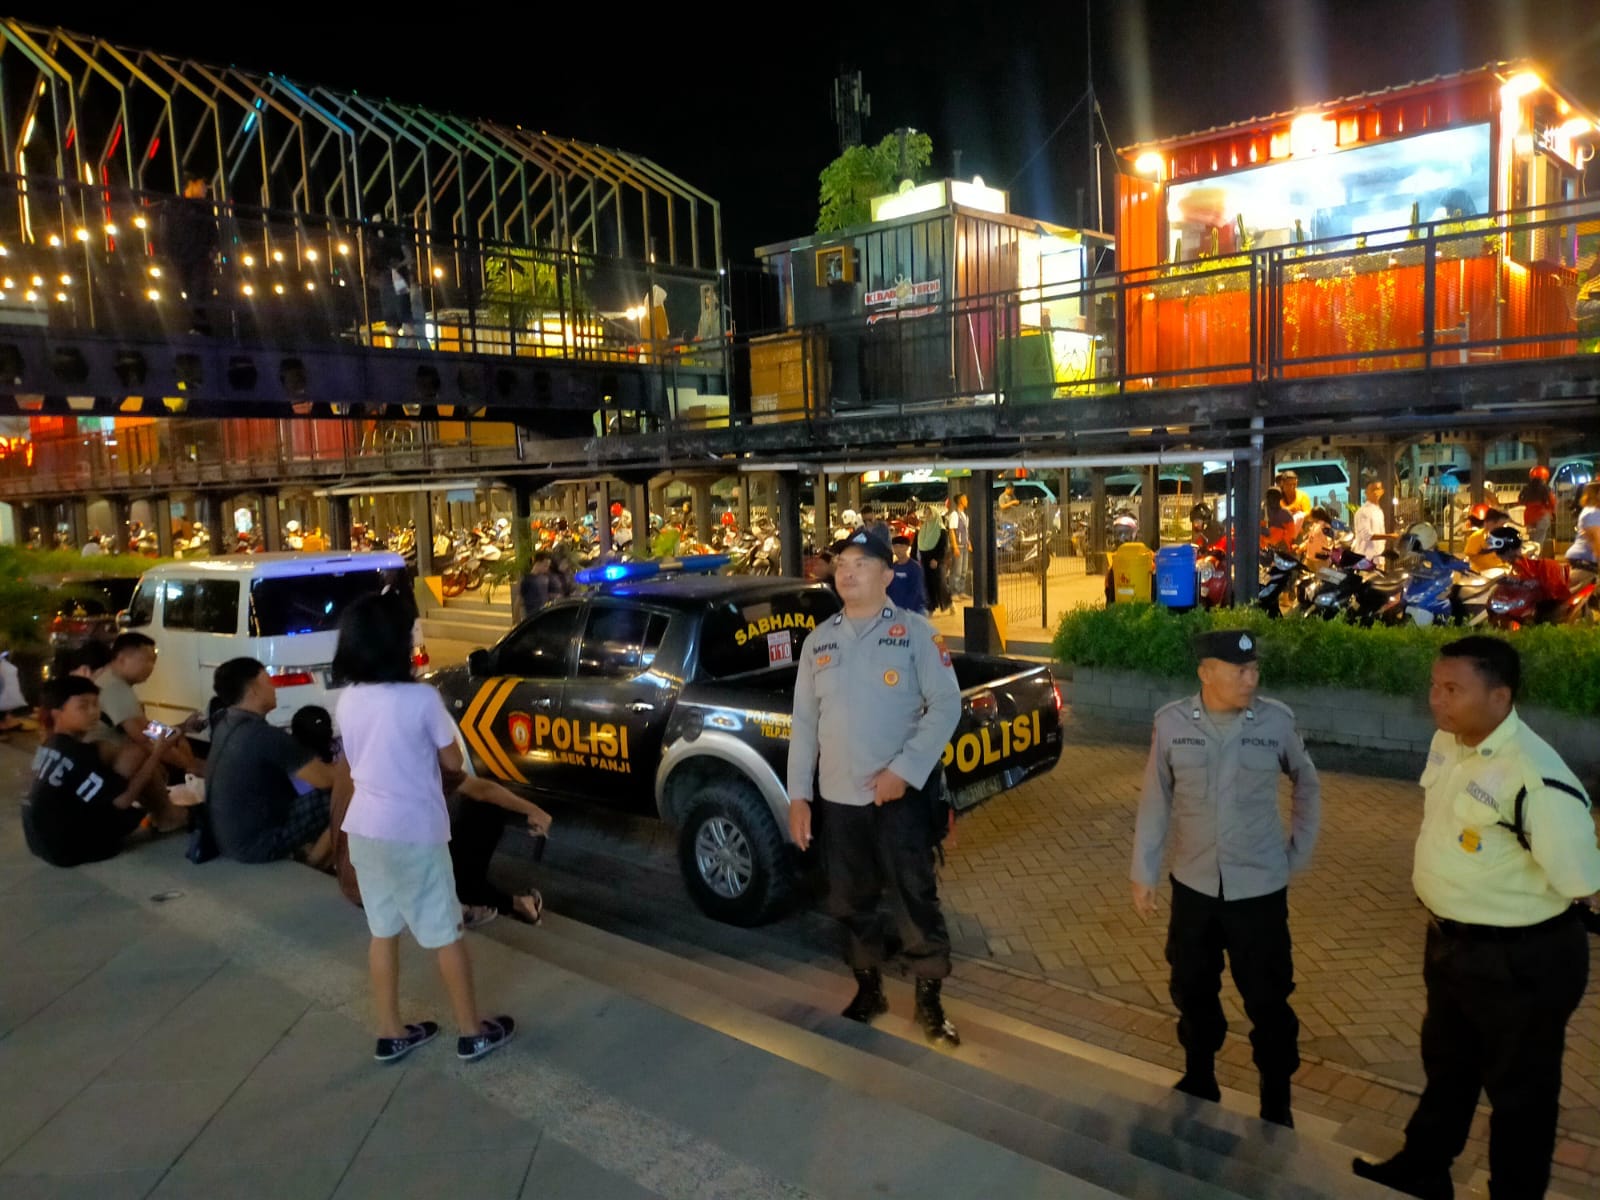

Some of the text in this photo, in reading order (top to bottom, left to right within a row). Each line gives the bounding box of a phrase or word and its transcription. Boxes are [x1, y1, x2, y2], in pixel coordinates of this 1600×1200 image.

[866, 288, 897, 305] KEBAB
[734, 612, 816, 646] SABHARA
[770, 642, 790, 662] 110
[878, 638, 910, 648] POLRI
[534, 714, 629, 760] POLISI
[941, 709, 1041, 773] POLISI
[1241, 738, 1279, 748] POLRI
[590, 756, 631, 774] PANJI
